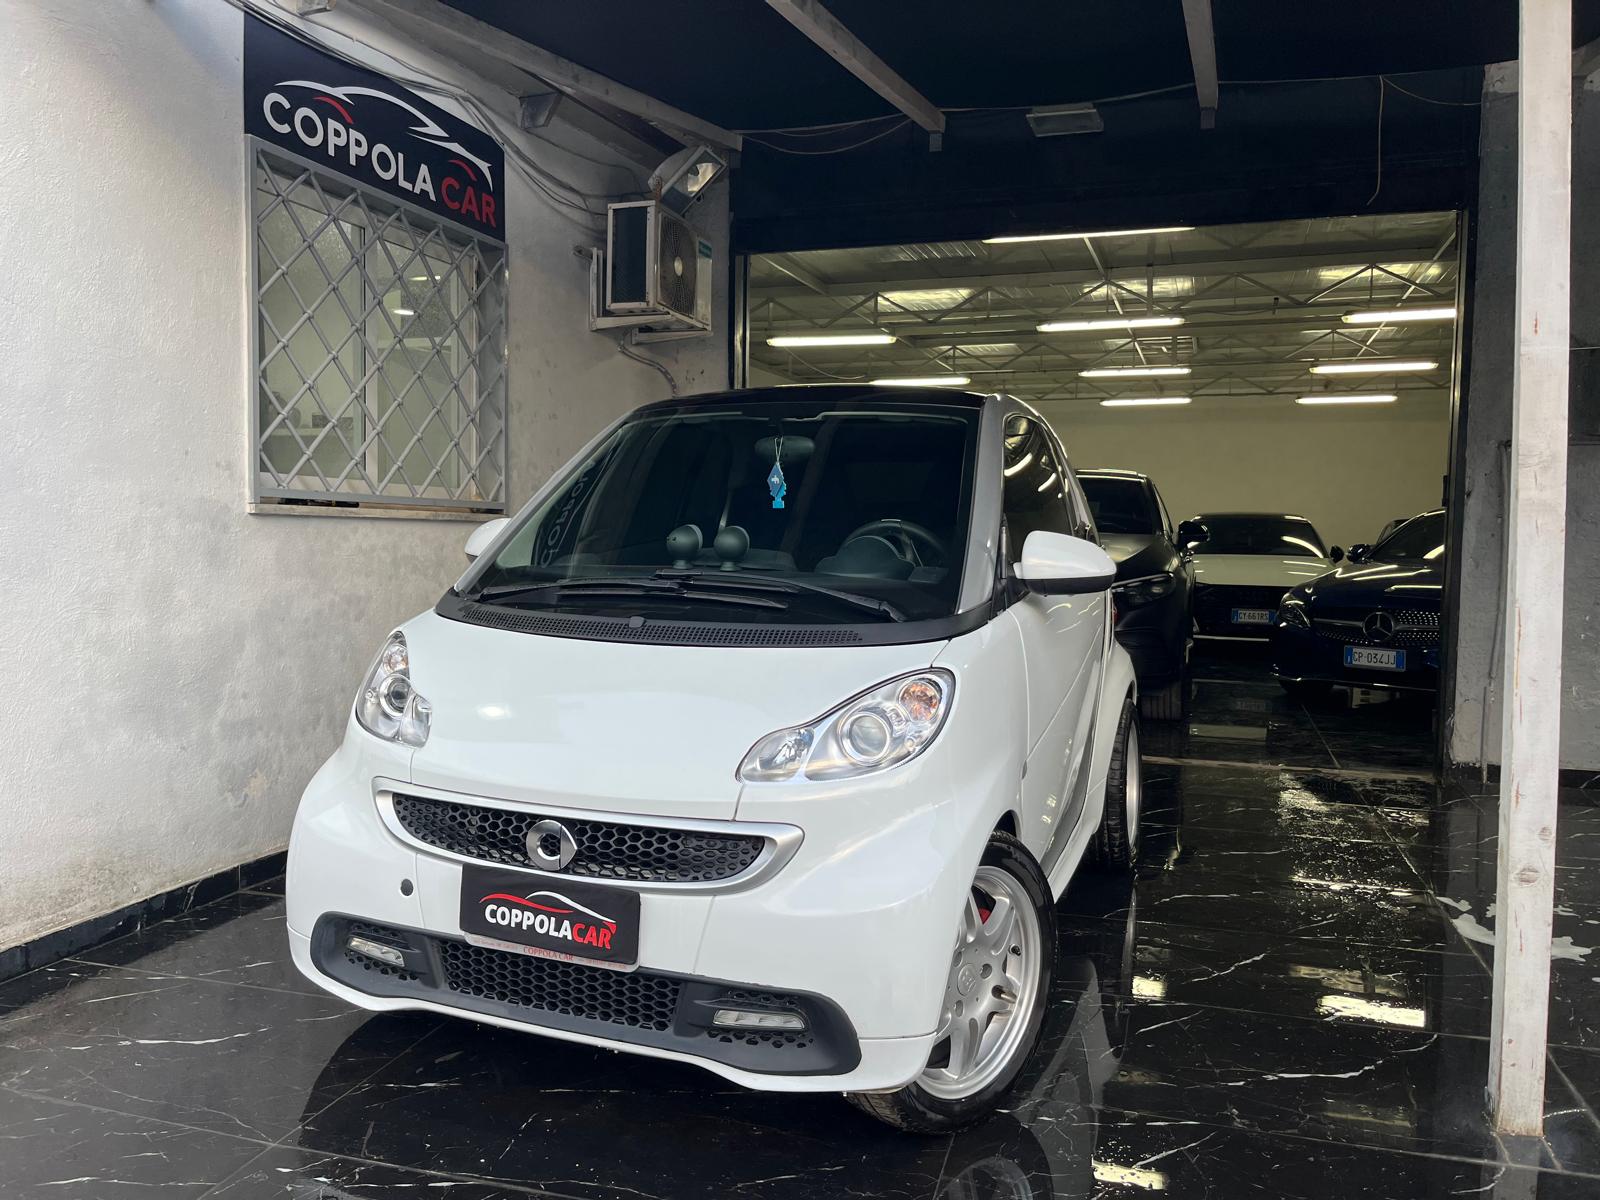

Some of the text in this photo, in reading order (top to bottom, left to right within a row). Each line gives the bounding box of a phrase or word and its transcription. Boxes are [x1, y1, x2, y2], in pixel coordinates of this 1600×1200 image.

[263, 92, 497, 227] COPPOLA CAR
[523, 945, 557, 959] COPPOLA
